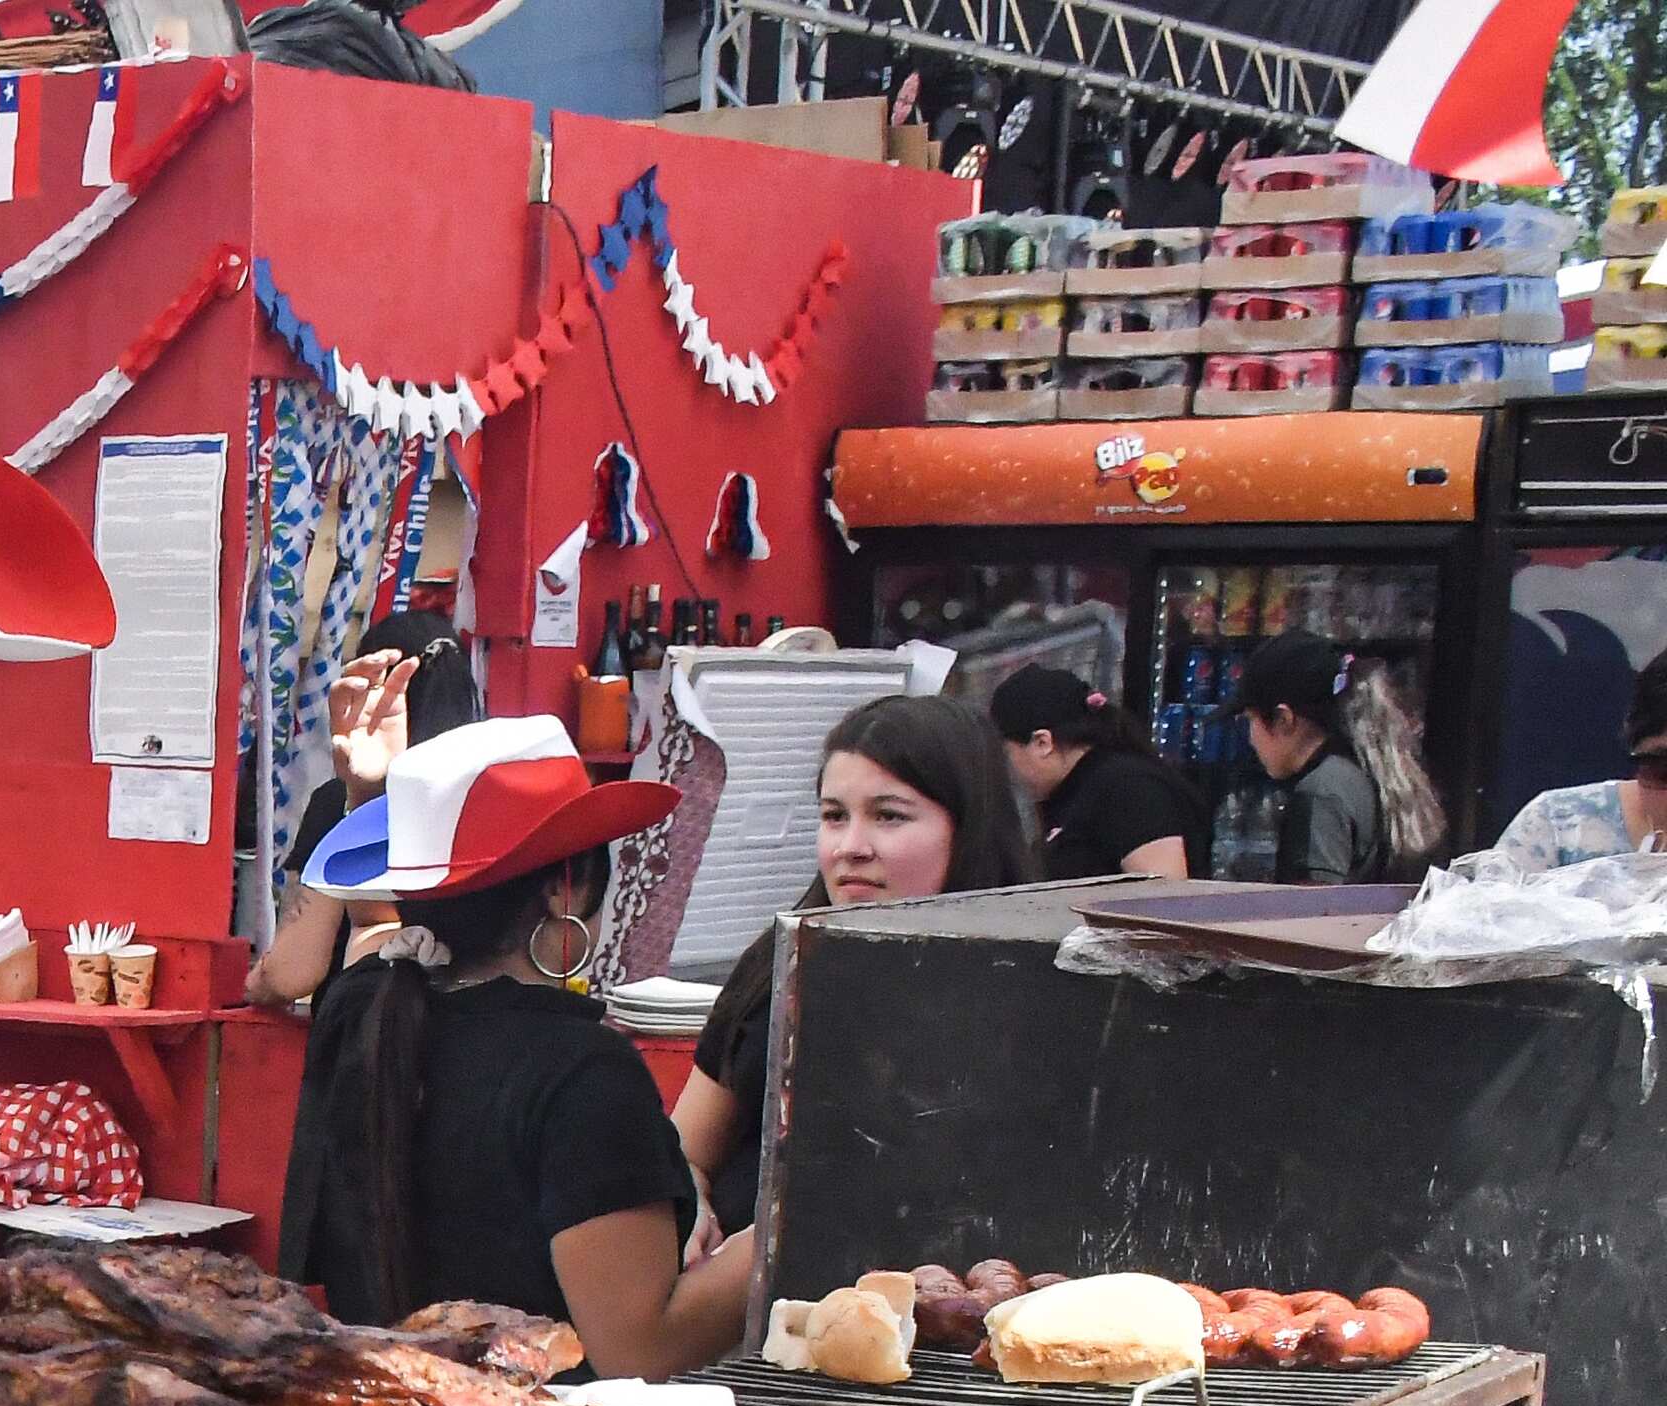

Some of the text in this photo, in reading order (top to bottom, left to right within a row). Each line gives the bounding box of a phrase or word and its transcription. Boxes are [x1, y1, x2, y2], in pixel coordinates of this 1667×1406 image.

[1097, 437, 1145, 471] Bilz
[405, 473, 432, 553] Chile
[378, 519, 405, 584] Viva
[393, 577, 413, 613] ile
